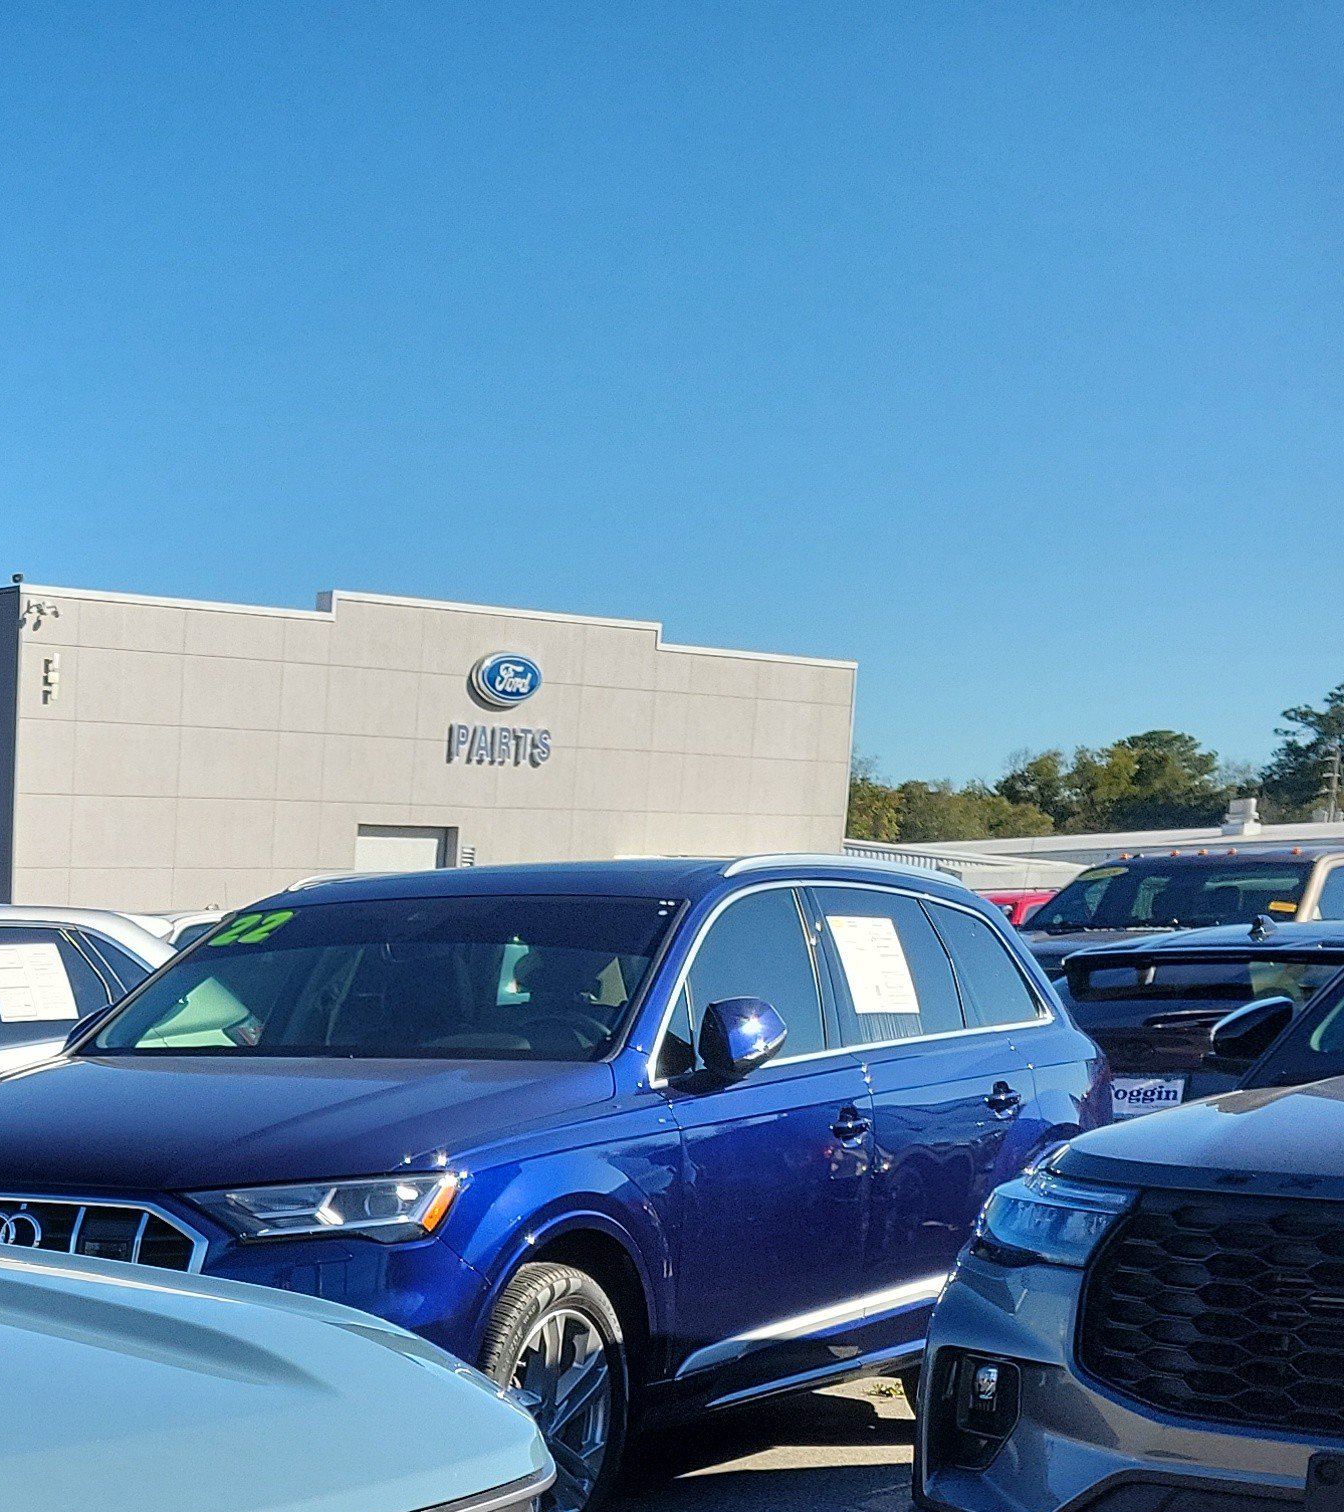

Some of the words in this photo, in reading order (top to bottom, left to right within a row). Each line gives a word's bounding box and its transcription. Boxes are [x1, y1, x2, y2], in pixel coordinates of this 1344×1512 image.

[495, 663, 533, 693] Ford
[452, 724, 552, 764] PARTS
[206, 911, 294, 947] 22
[1110, 1084, 1179, 1104] oggin
